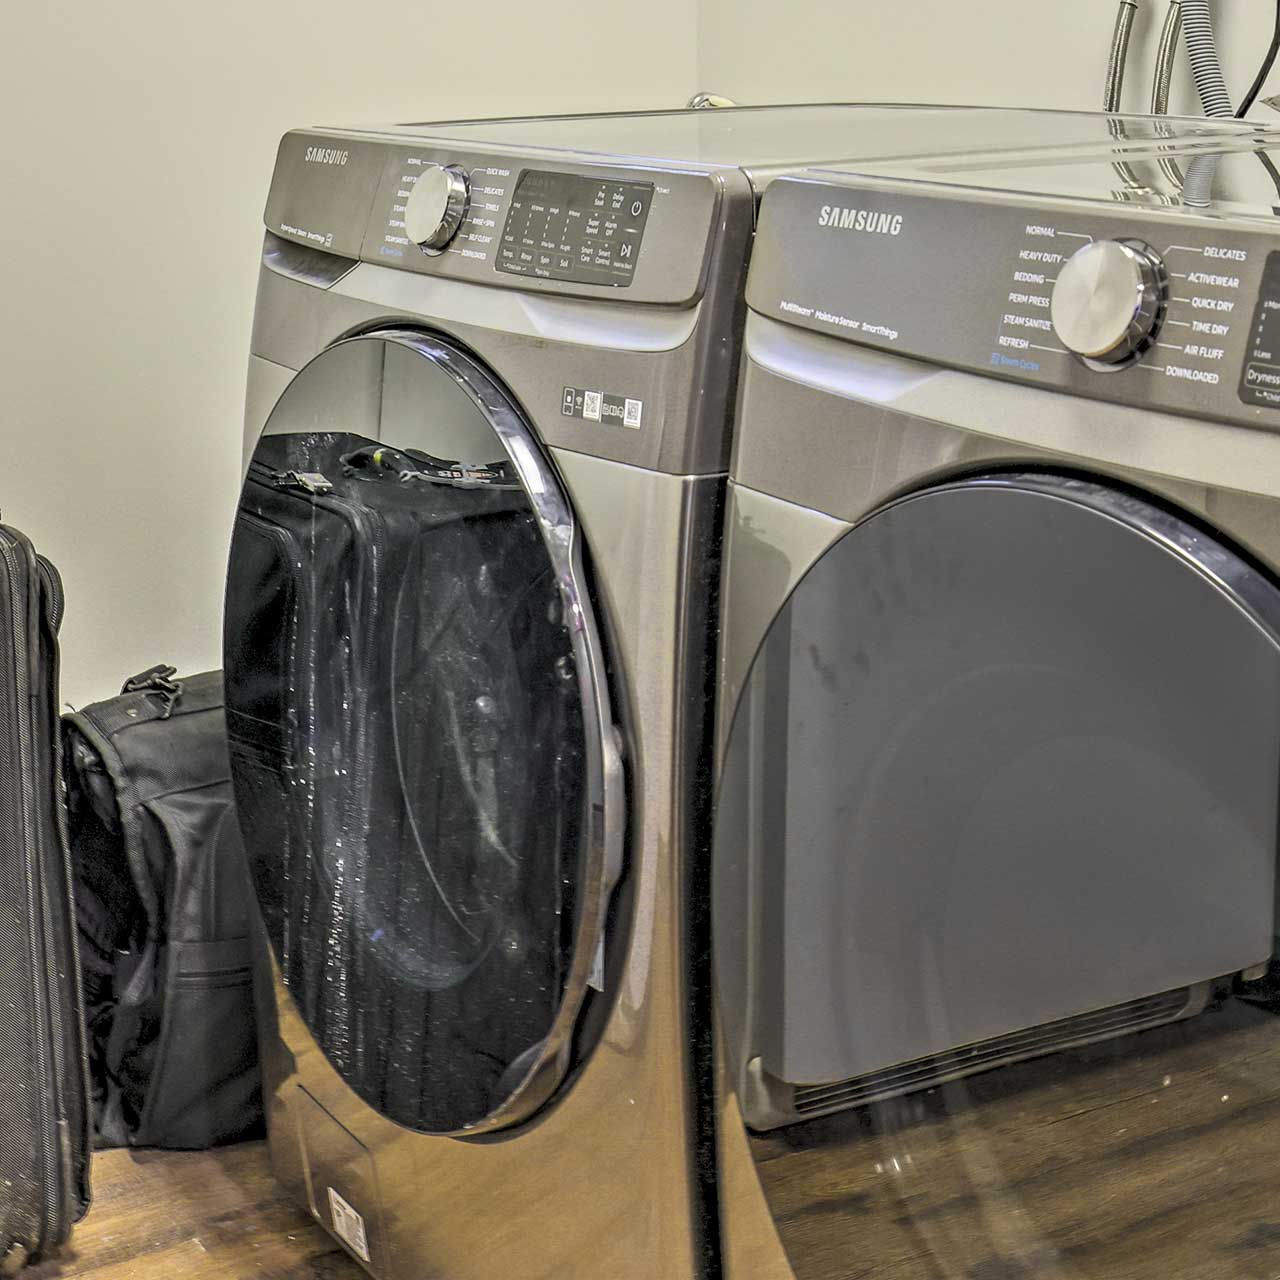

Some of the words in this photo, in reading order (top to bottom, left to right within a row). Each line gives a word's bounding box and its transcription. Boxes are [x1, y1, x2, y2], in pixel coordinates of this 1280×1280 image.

[305, 146, 349, 166] SAMSUNG
[818, 205, 903, 235] SAMSUNG
[1025, 225, 1055, 237] NORMAL
[1019, 250, 1042, 261] HEAVY
[1042, 253, 1062, 264] DUTY
[1204, 246, 1248, 261] DELICATES
[1014, 271, 1045, 284] BEDDING
[1187, 272, 1240, 289] ACTIVEWEAR
[1008, 292, 1028, 304] PERM
[1028, 295, 1050, 308] PRESS
[1191, 297, 1217, 310] QUICK
[1217, 301, 1234, 312] DRY
[838, 316, 860, 329] Sensor
[862, 322, 898, 340] SmartThings
[1004, 314, 1025, 326] STEAM
[1024, 317, 1053, 331] SANITIZE
[1192, 321, 1213, 334] TIME
[1212, 324, 1229, 336] DRY
[998, 336, 1029, 349] REFRESH
[1184, 344, 1199, 356] AIR
[1198, 346, 1225, 359] FLUFF
[1165, 365, 1220, 384] DOWNLOADED
[1248, 369, 1280, 386] Dryness
